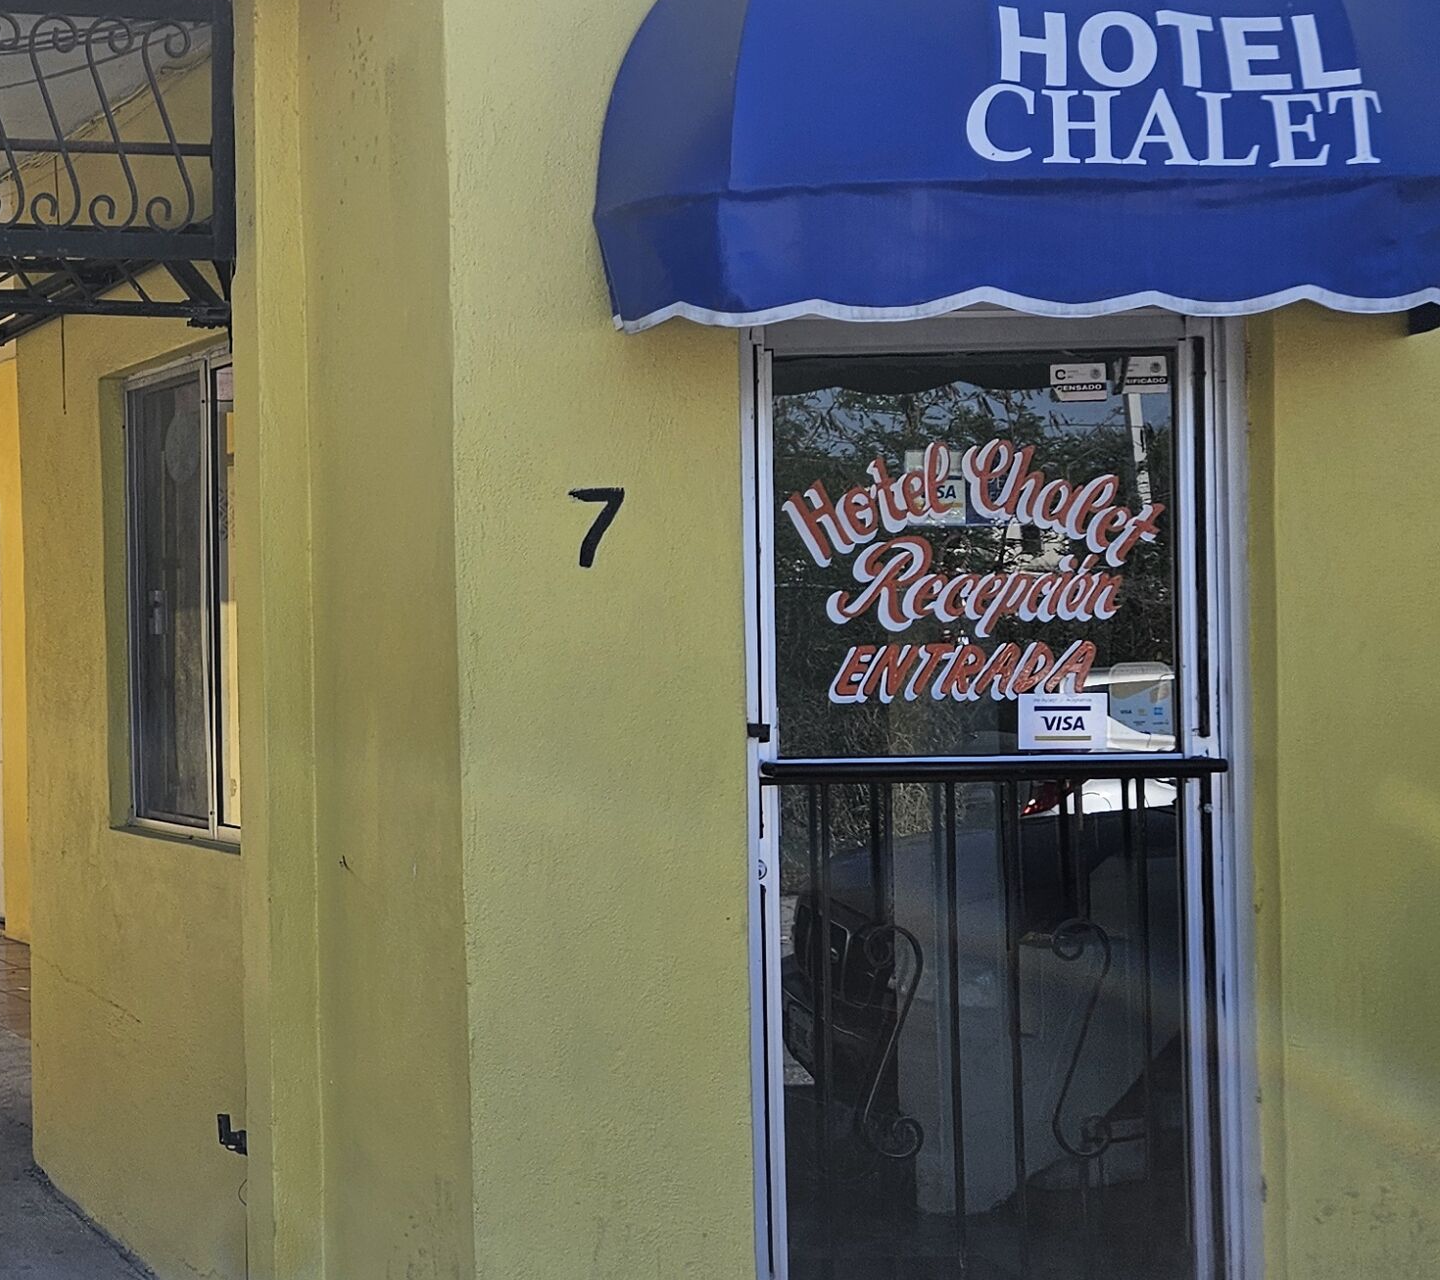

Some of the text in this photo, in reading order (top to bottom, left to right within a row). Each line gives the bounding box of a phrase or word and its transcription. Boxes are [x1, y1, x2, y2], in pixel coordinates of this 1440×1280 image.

[998, 6, 1362, 91] HOTEL
[966, 83, 1383, 168] CHALET
[568, 487, 625, 568] 7
[782, 438, 1166, 568] Hotel Chalet
[826, 535, 1123, 639] Recepción
[828, 639, 1097, 704] ENTRADA
[1041, 716, 1086, 732] VISA
